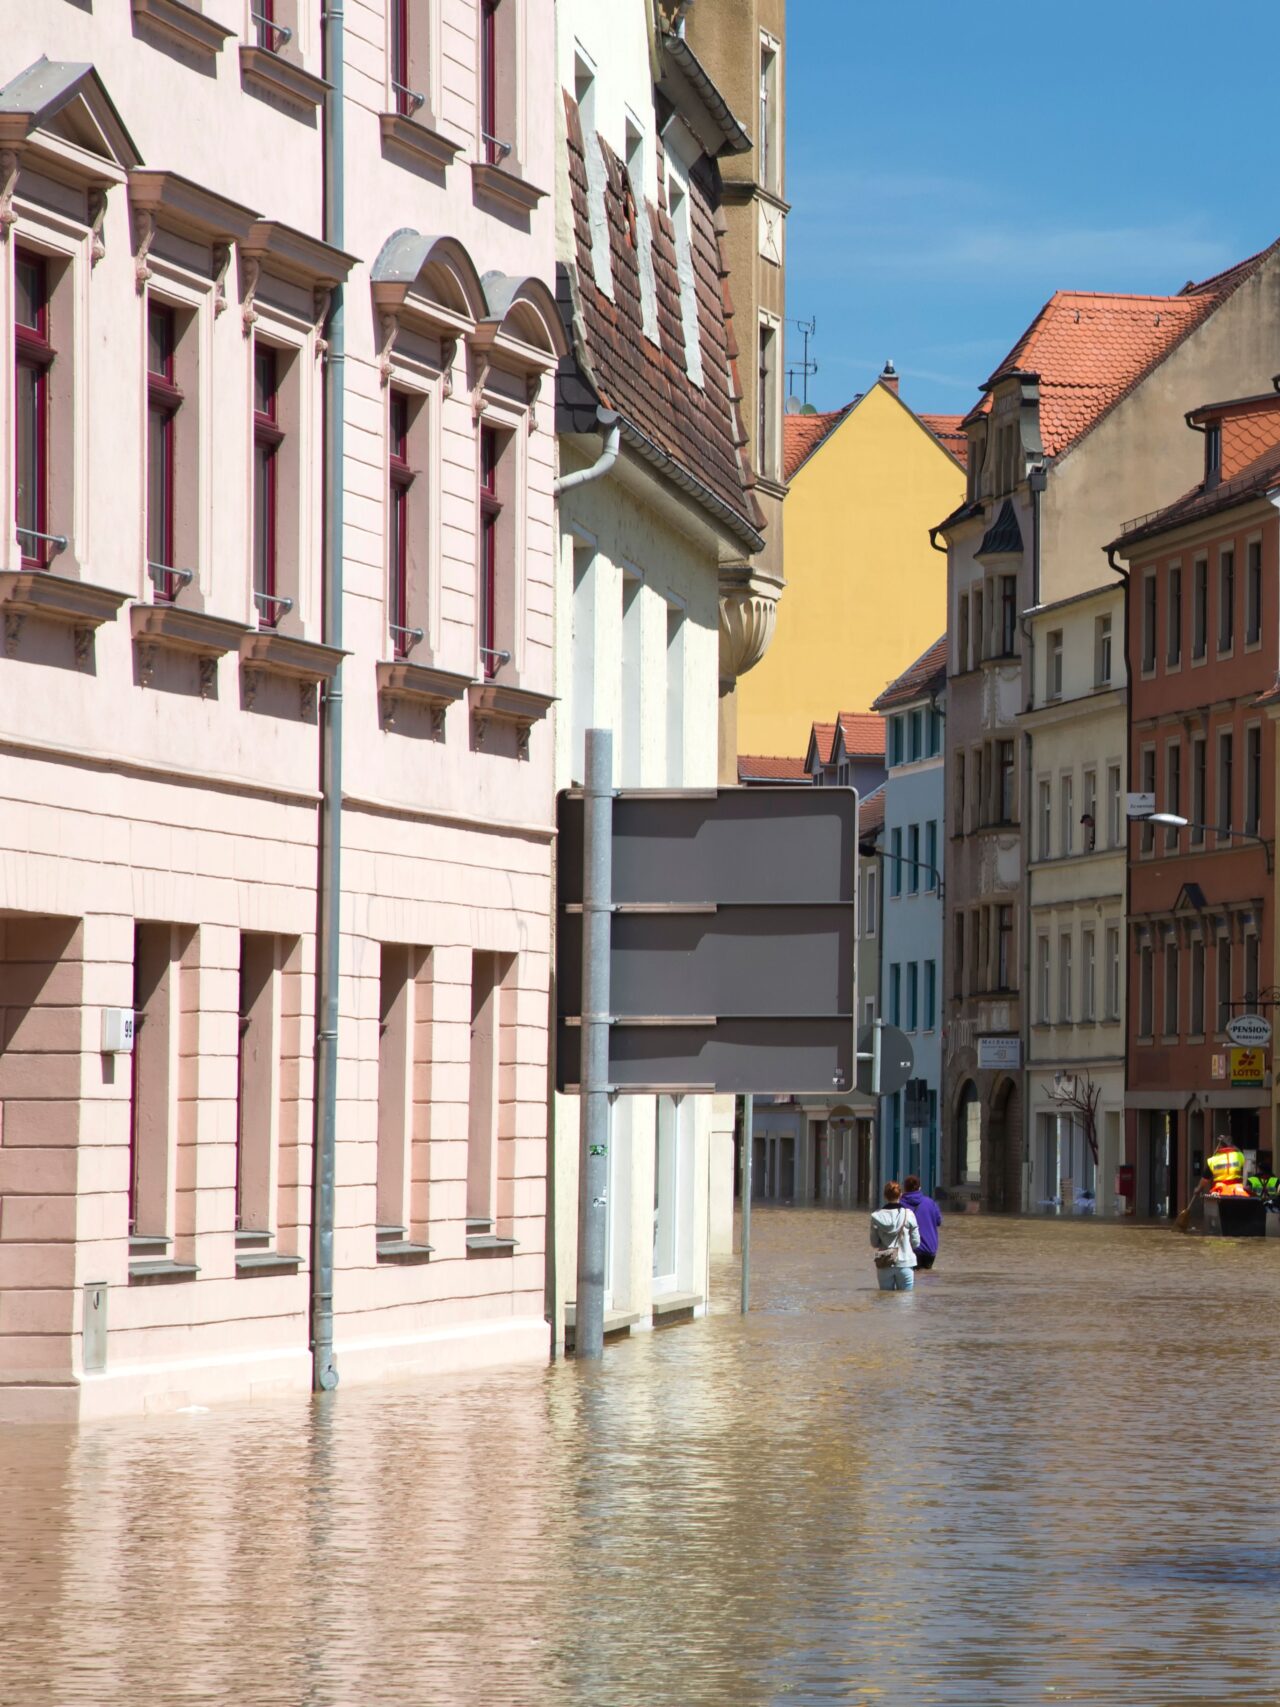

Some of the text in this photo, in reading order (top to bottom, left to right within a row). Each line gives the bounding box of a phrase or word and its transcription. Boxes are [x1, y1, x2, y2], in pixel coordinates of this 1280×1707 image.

[125, 1020, 132, 1038] 99
[1232, 1025, 1269, 1034] PENSION
[1232, 1069, 1261, 1077] LOTTO
